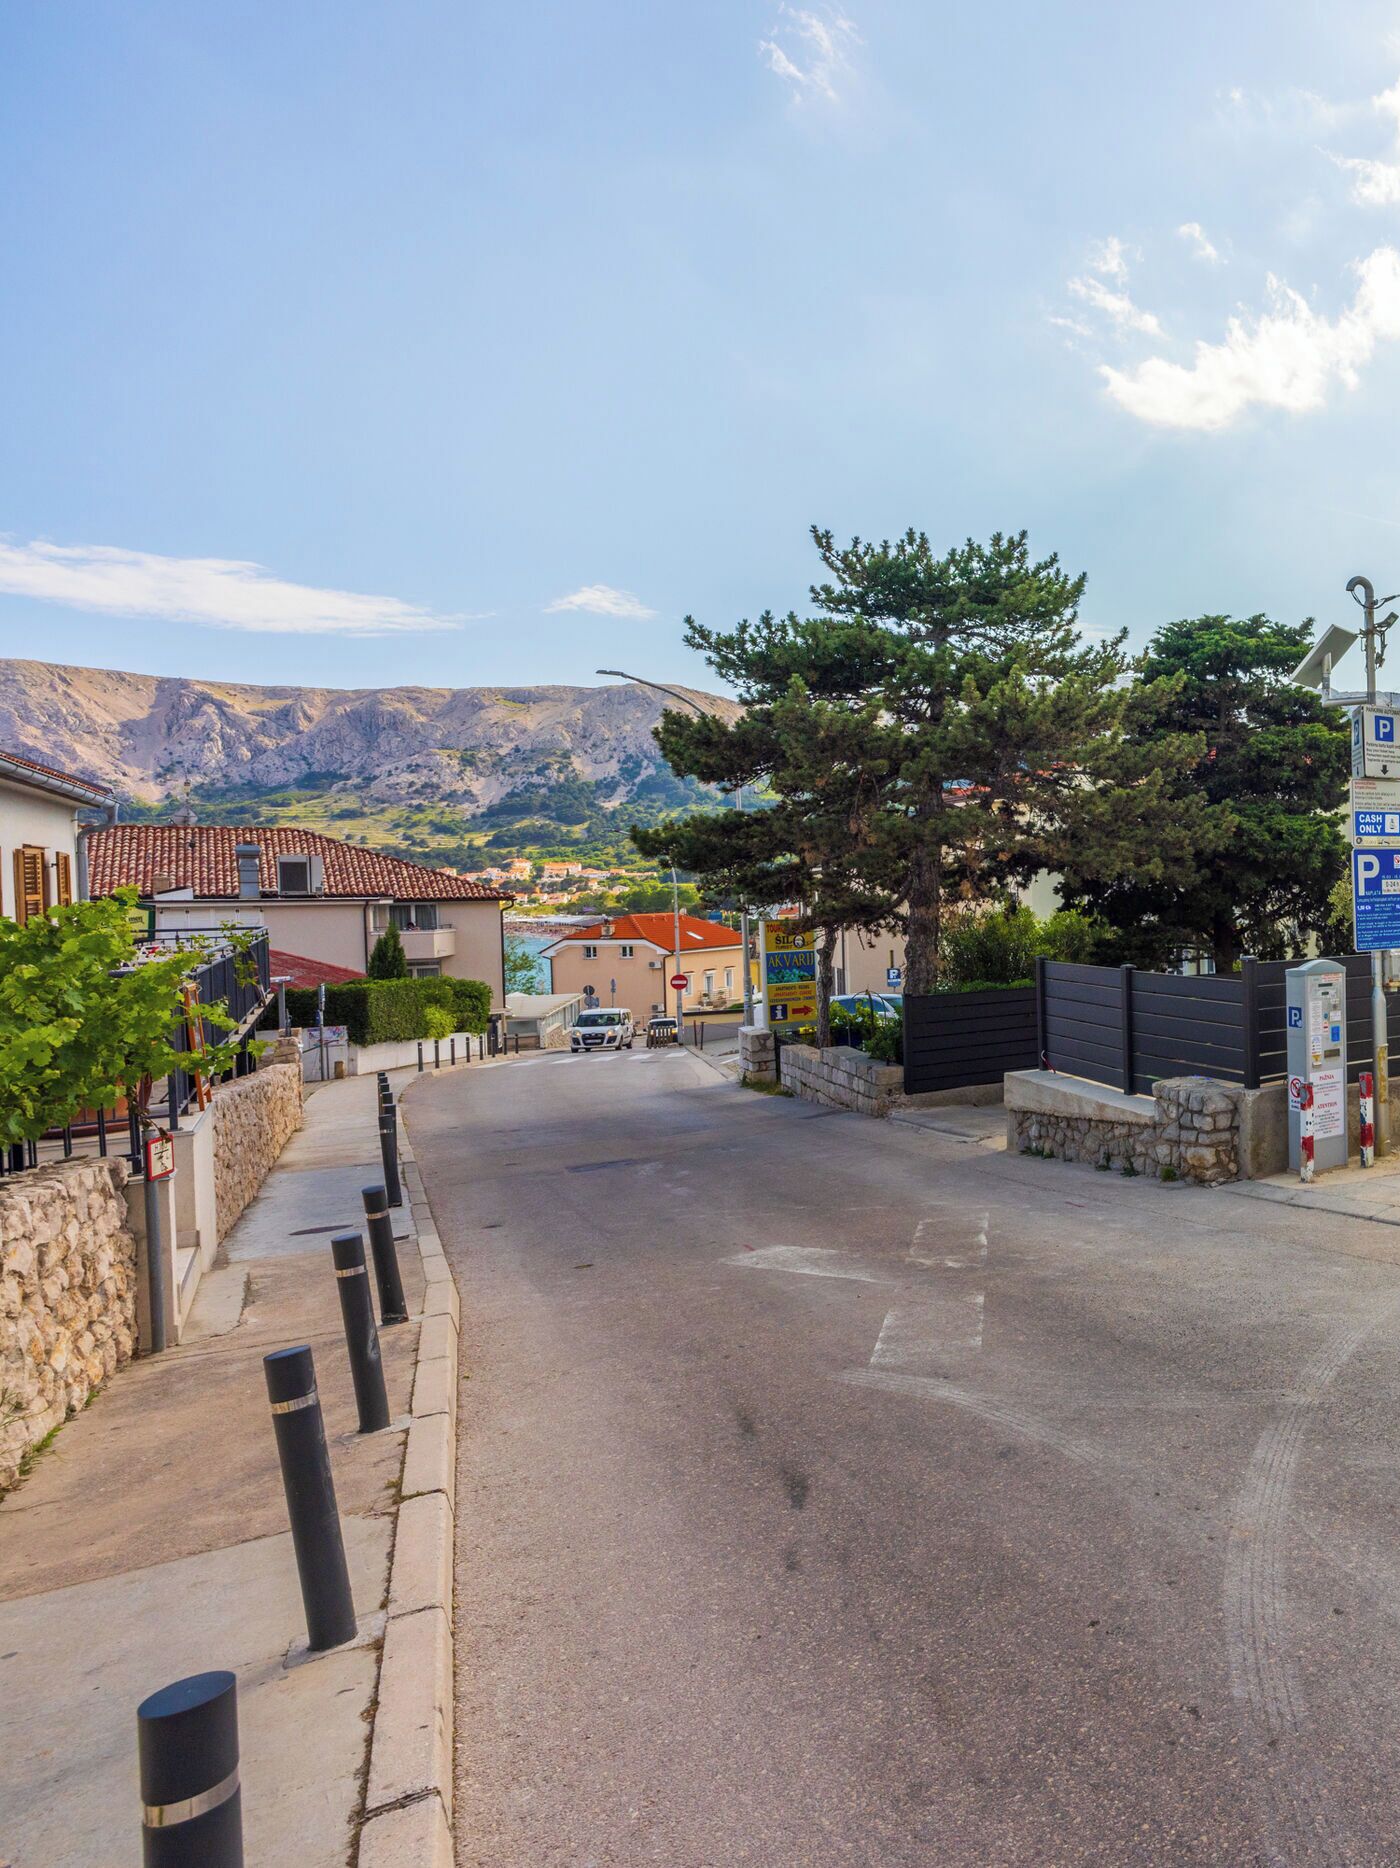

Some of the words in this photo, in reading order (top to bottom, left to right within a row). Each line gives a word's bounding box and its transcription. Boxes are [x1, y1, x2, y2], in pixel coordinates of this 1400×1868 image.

[1379, 719, 1391, 739] P
[1359, 814, 1382, 823] CASH
[1359, 824, 1382, 833] ONLY
[1357, 854, 1380, 896] P
[1292, 1010, 1300, 1025] P
